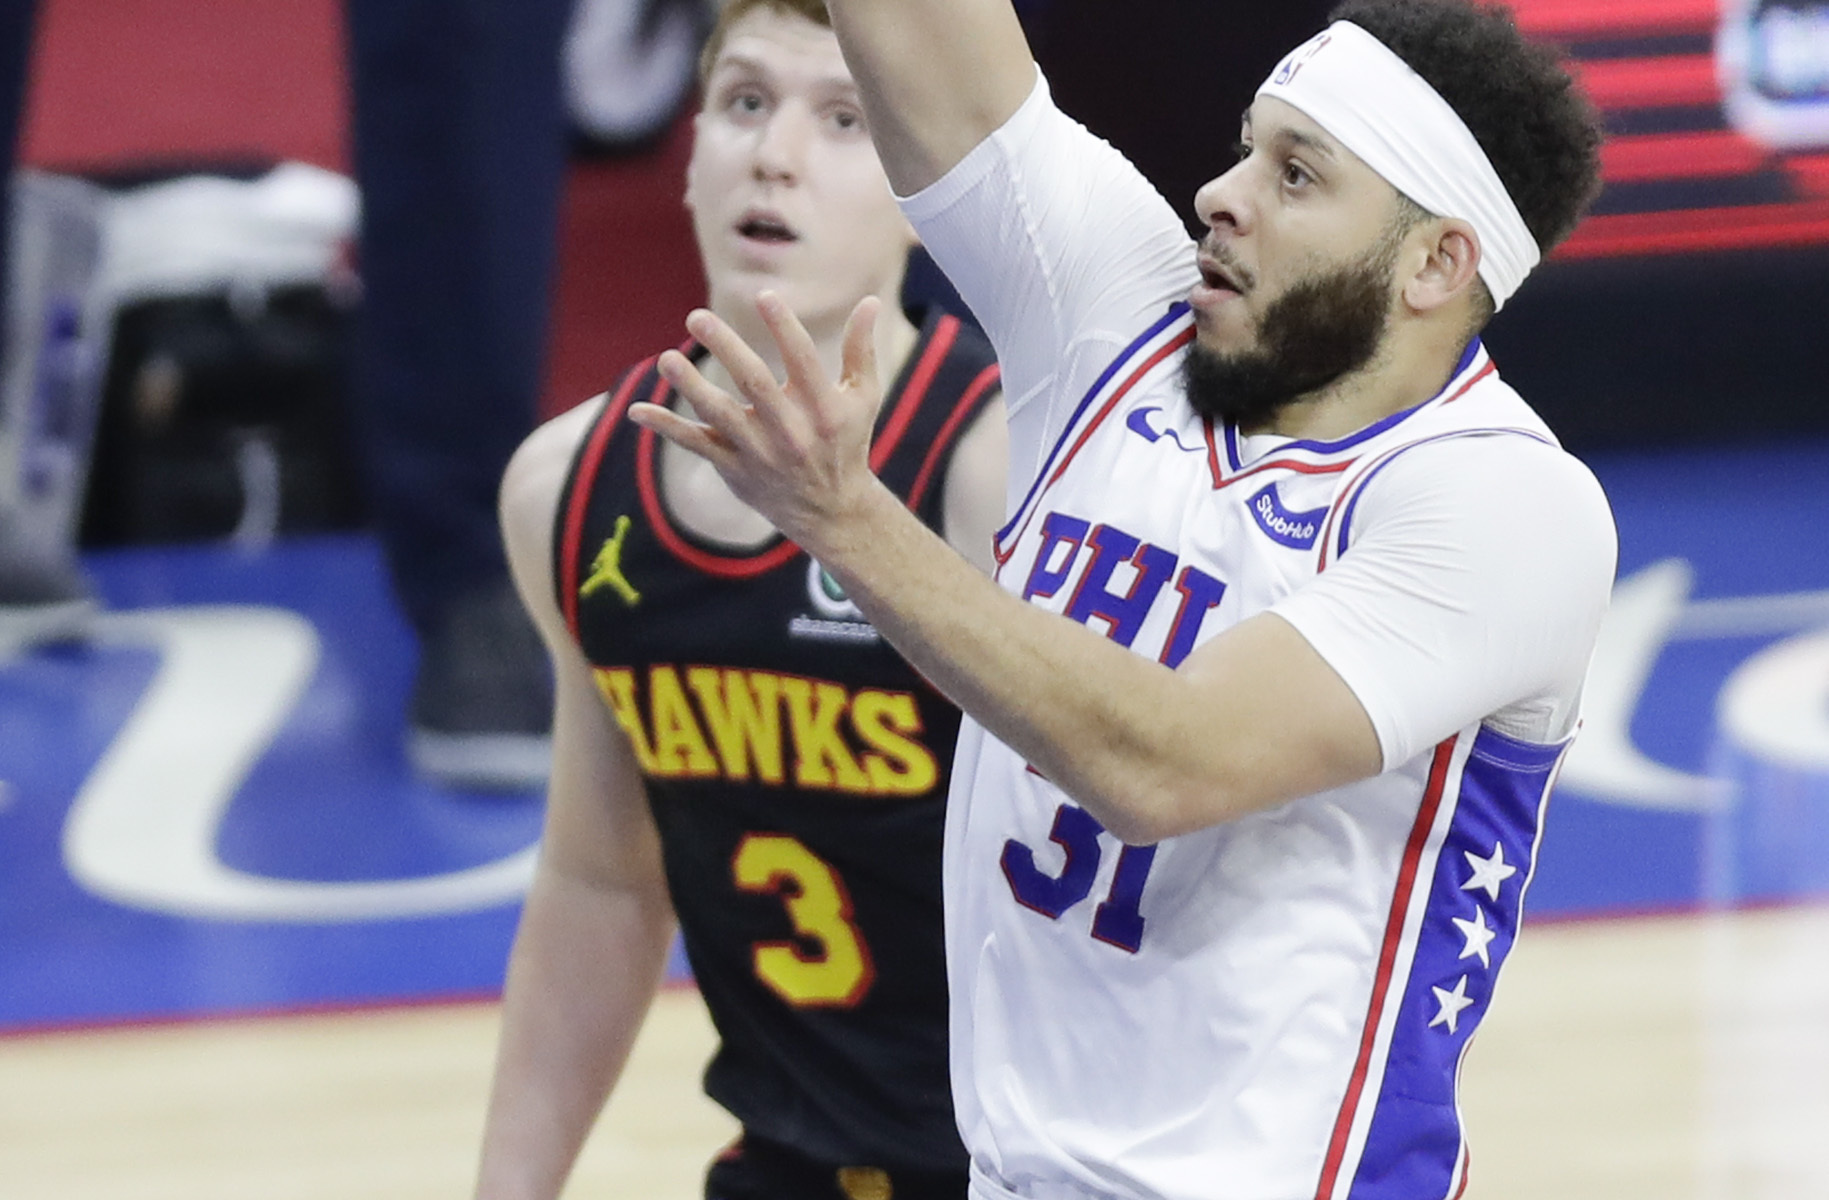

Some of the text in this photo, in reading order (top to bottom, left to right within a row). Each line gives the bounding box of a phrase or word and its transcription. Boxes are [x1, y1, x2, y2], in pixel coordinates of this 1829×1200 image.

[1256, 494, 1315, 539] StubHub
[592, 663, 940, 796] HAWKS
[732, 831, 875, 1009] 3
